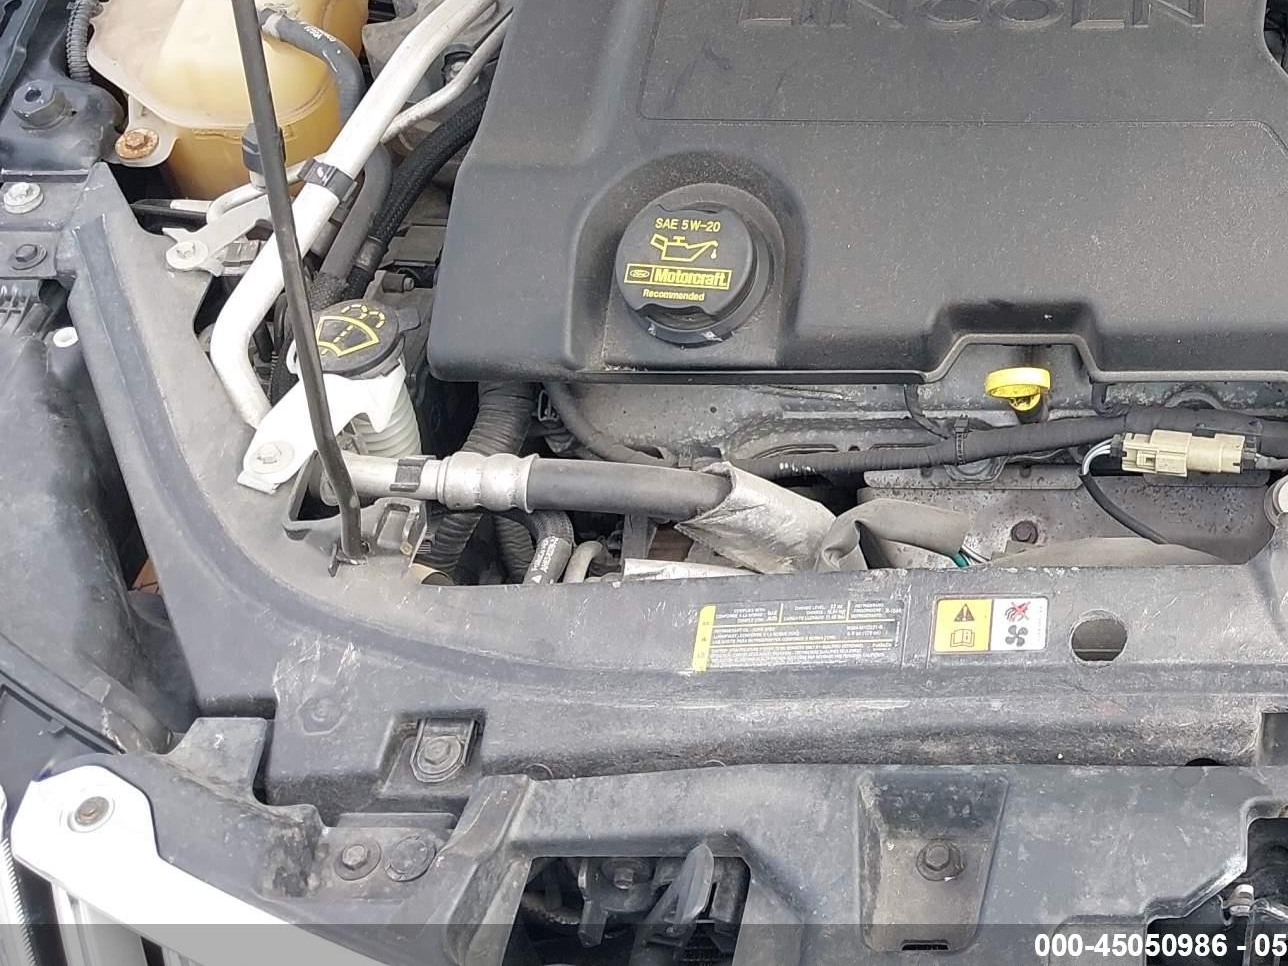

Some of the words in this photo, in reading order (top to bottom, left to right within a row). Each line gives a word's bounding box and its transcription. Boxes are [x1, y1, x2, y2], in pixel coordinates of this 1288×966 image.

[655, 217, 678, 230] SAE
[681, 219, 721, 232] 5W-20
[654, 268, 727, 286] Motorcraft
[643, 289, 705, 301] Recommended
